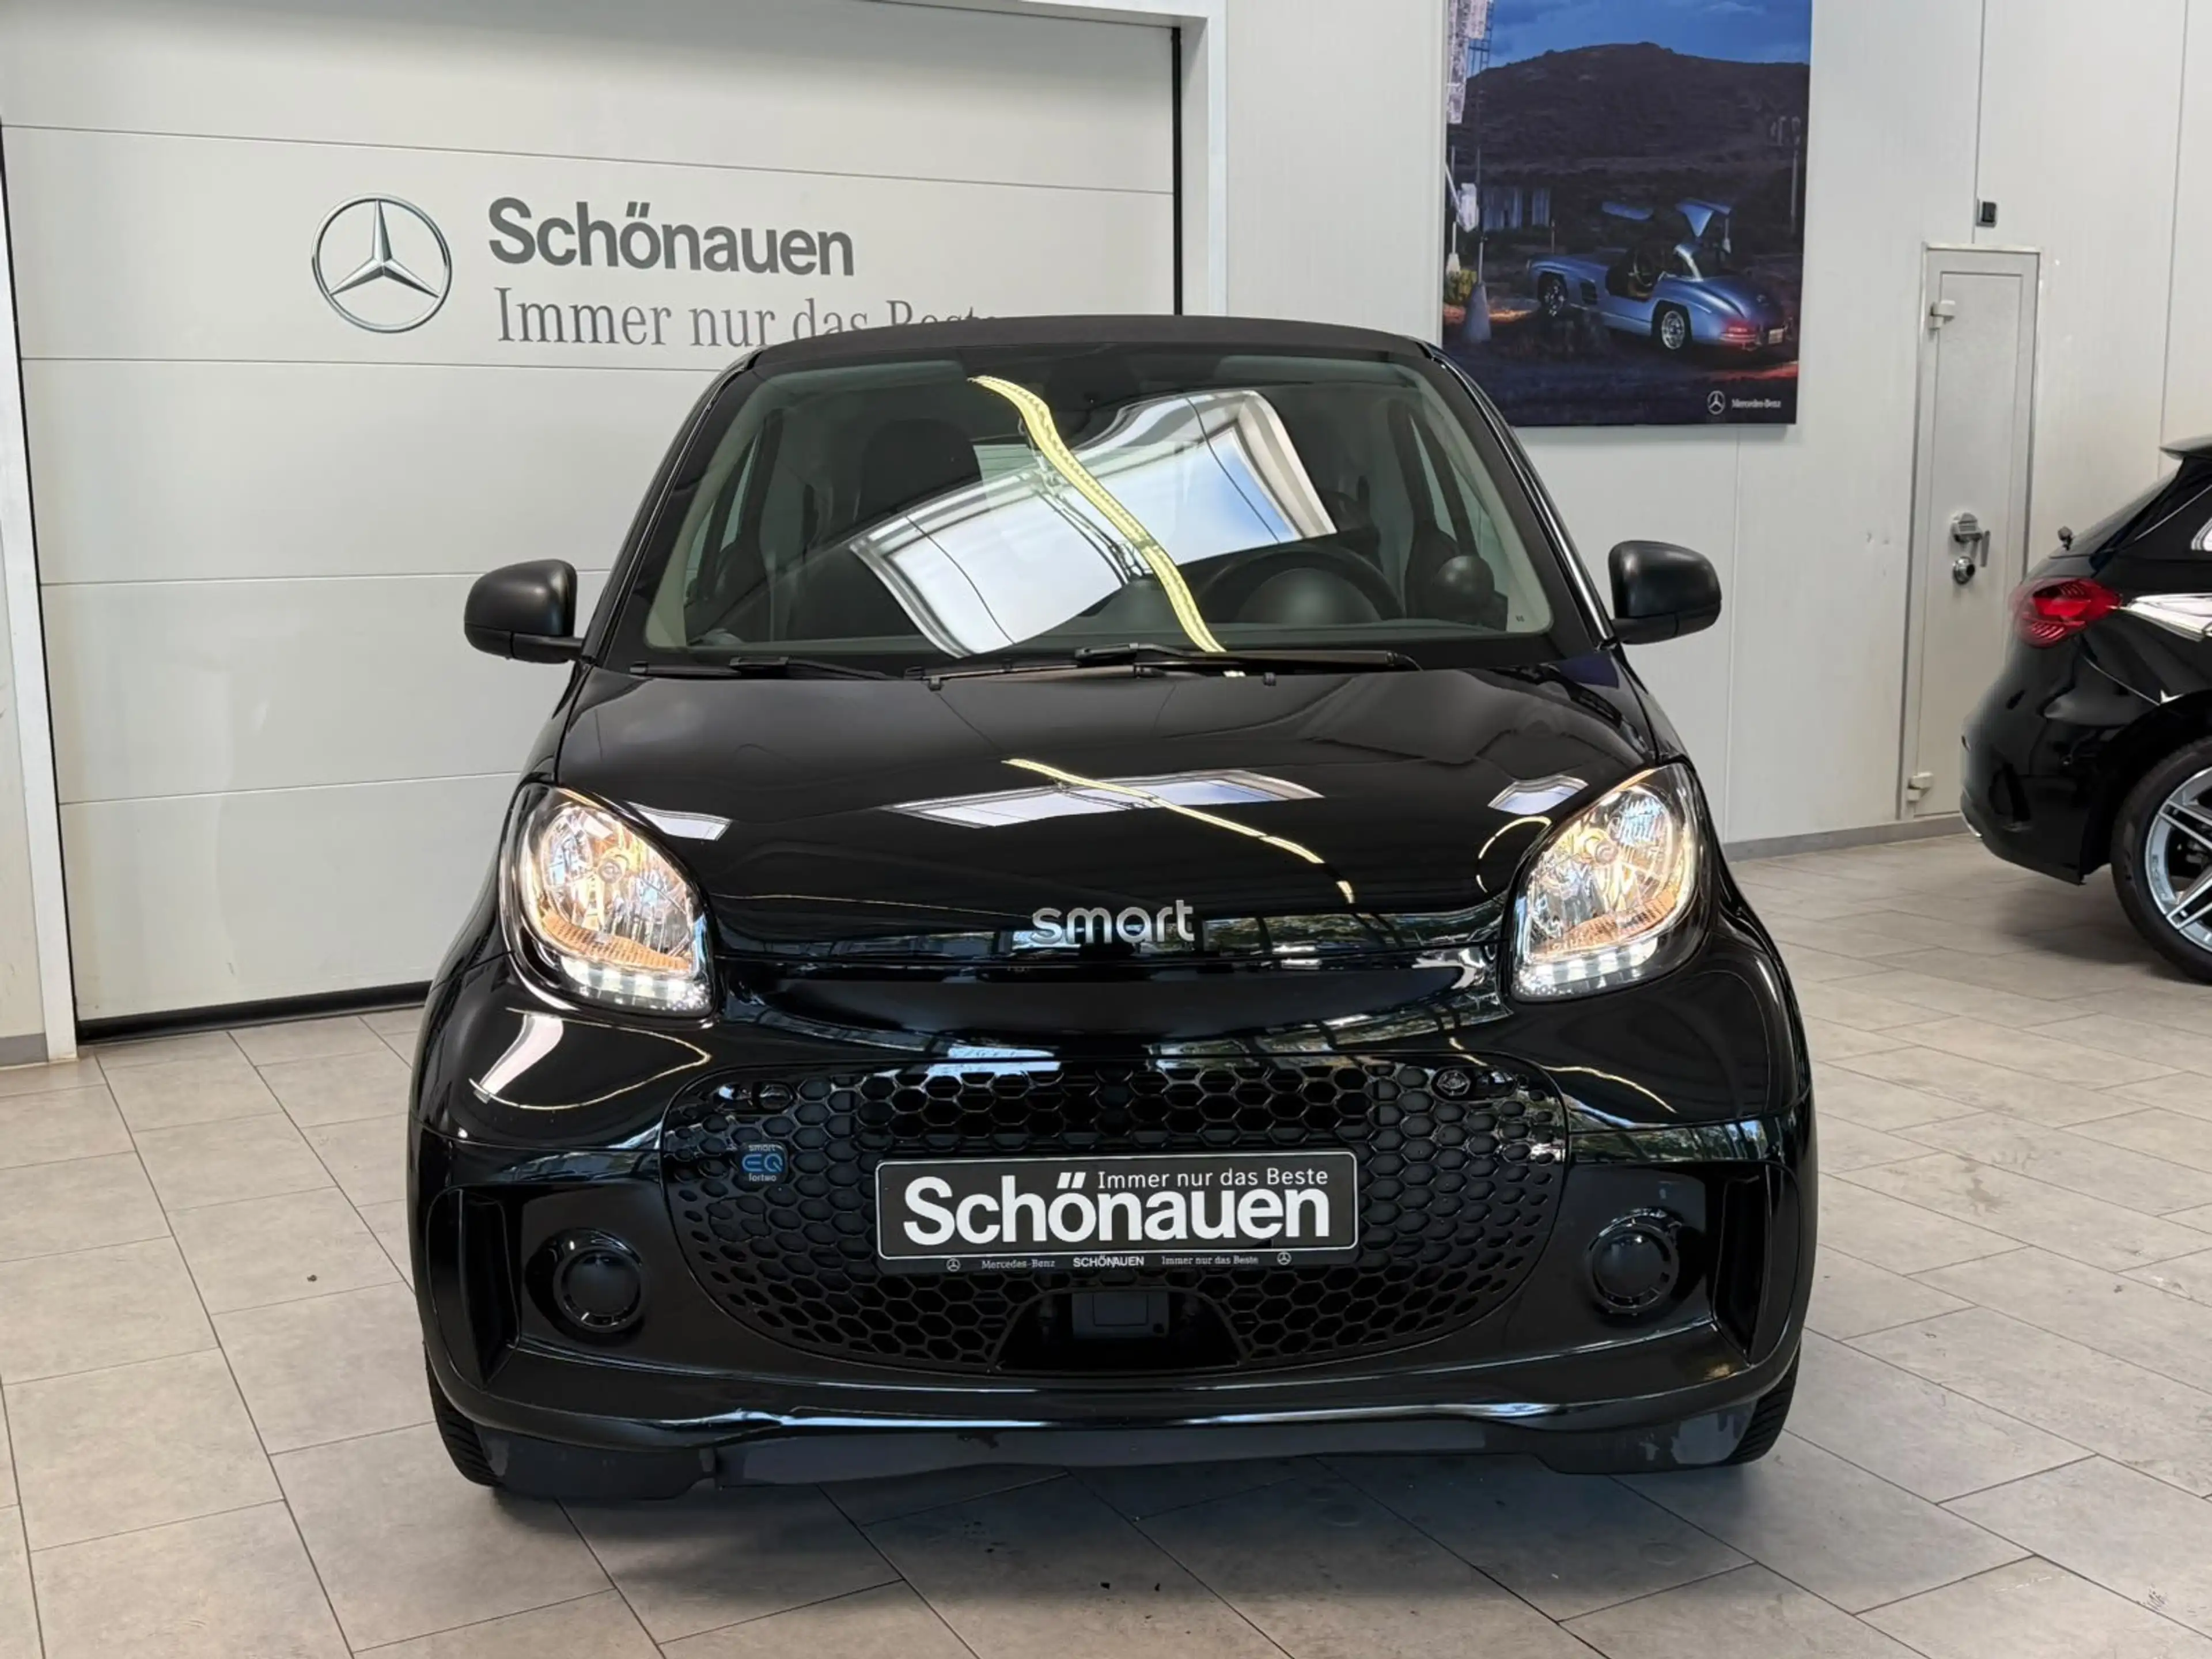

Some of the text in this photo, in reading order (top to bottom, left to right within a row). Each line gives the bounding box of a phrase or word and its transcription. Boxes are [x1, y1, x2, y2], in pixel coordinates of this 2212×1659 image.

[488, 196, 854, 276] Schönauen
[494, 287, 672, 346] Immer
[690, 304, 775, 347] nur
[1032, 899, 1195, 945] smart
[742, 1153, 783, 1172] EQ
[1097, 1168, 1328, 1189] Immer nur das Beste
[903, 1172, 1330, 1246] Schönauen
[981, 1259, 1055, 1270] Mercedes-Benz
[1073, 1254, 1145, 1267] SCHÖNAUEN
[1161, 1255, 1259, 1265] Immer nur das Beste
